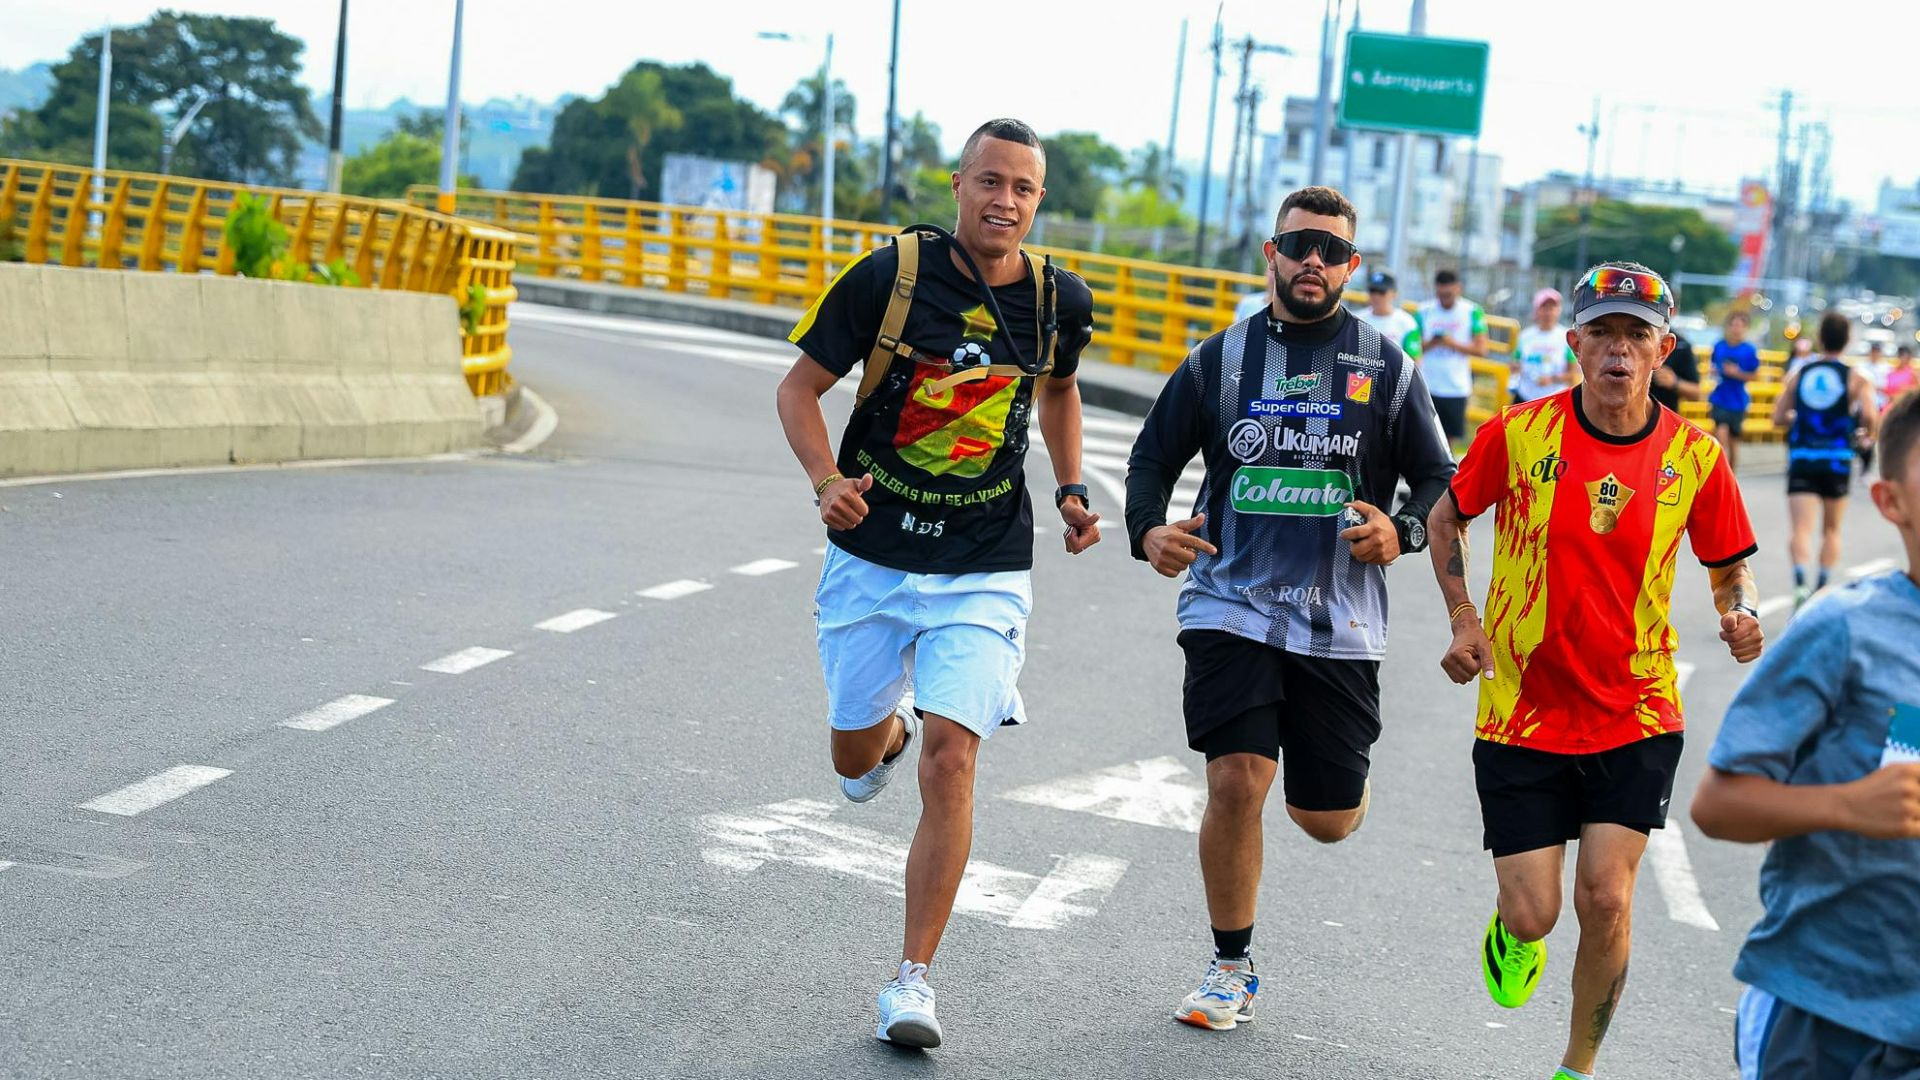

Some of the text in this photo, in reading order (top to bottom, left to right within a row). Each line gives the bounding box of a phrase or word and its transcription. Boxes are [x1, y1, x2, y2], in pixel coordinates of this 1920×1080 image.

[1371, 69, 1475, 95] Aeropuerto
[1337, 352, 1386, 368] AREANDINA
[1250, 400, 1341, 416] Super GIROS
[868, 462, 920, 501] COLEGAS
[921, 491, 942, 504] NO
[945, 494, 963, 507] SE
[1233, 474, 1351, 505] Colanta
[1600, 482, 1619, 498] 80
[1597, 496, 1617, 507] AÑOS
[1233, 584, 1275, 597] TAPA
[1276, 584, 1323, 607] ROJA
